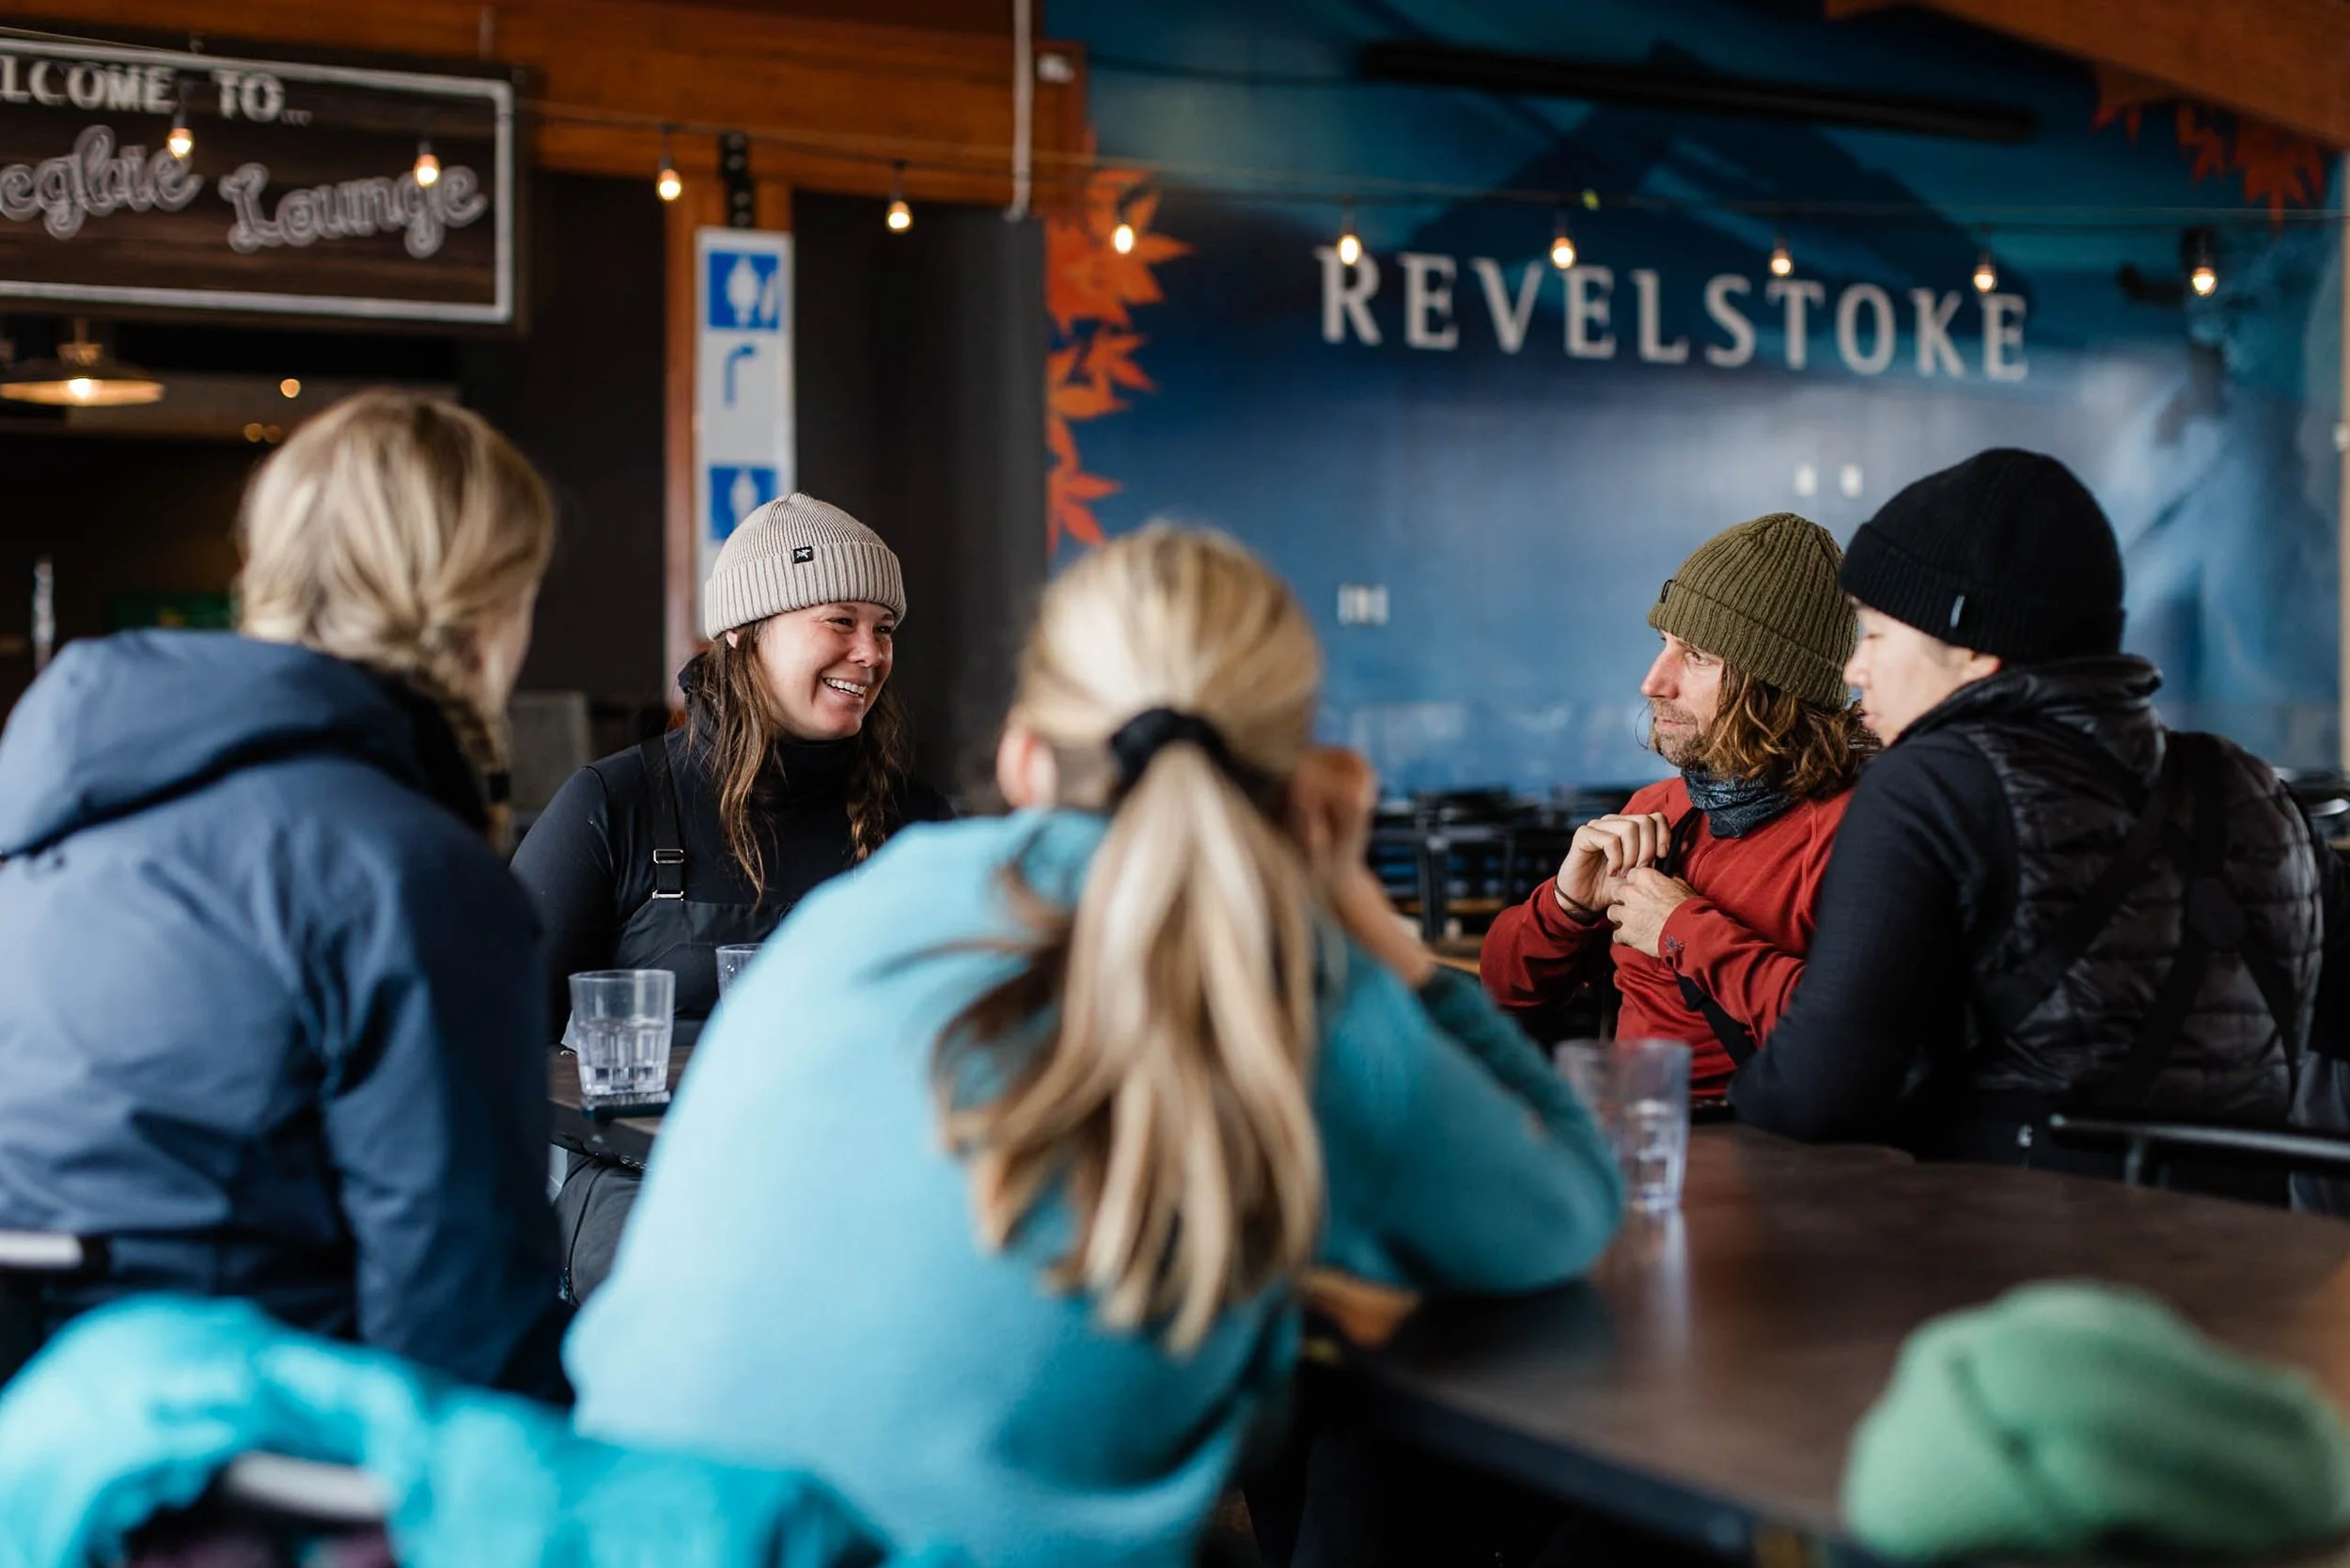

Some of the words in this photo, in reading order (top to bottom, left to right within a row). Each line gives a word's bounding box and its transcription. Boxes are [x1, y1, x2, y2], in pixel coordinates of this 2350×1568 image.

[0, 55, 177, 114] LCOME
[218, 162, 488, 259] Lounge
[1314, 246, 2029, 382] REVELSTOKE
